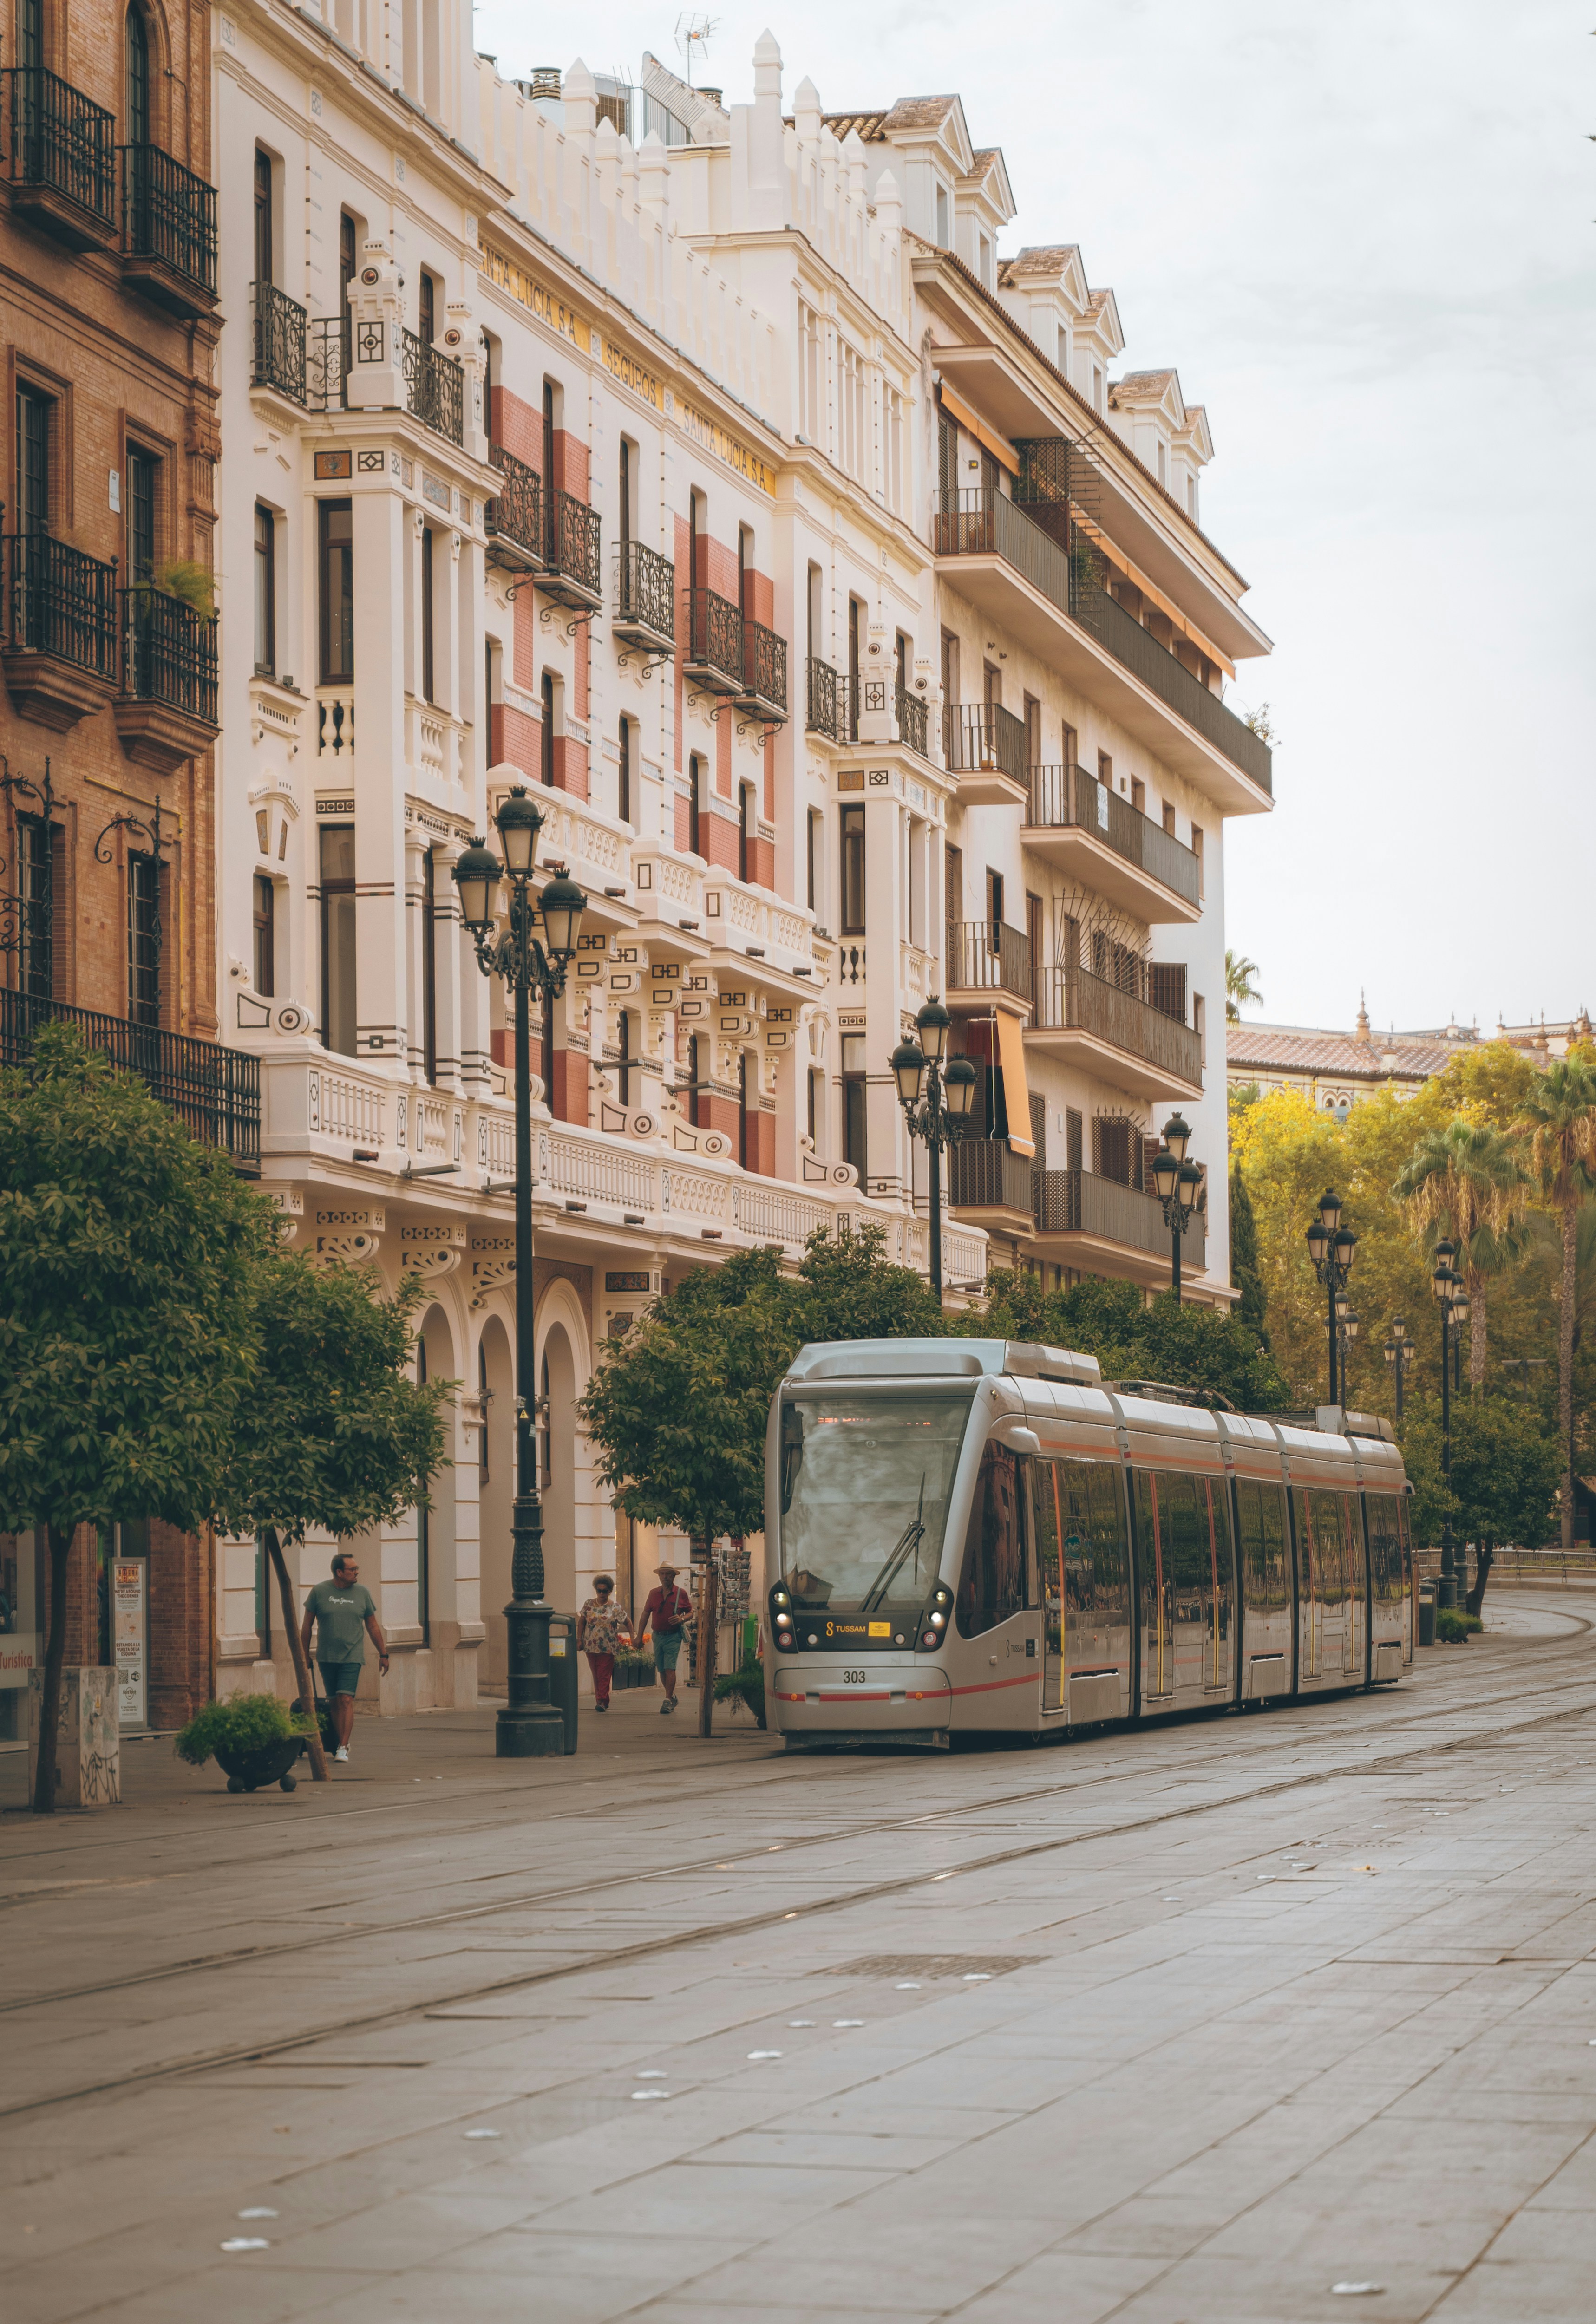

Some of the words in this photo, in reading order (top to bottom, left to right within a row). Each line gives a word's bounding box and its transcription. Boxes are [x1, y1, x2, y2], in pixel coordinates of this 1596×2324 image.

[478, 241, 510, 293] ANTA
[517, 271, 555, 328] LUCIA
[558, 305, 565, 334] S
[569, 313, 578, 346] A
[607, 343, 656, 407] SEGUROS
[684, 404, 716, 454] SANTA
[720, 431, 749, 479] LUCIA
[752, 457, 758, 486] S
[759, 463, 767, 492] A
[0, 1650, 32, 1669] Turística
[843, 1671, 866, 1684] 303
